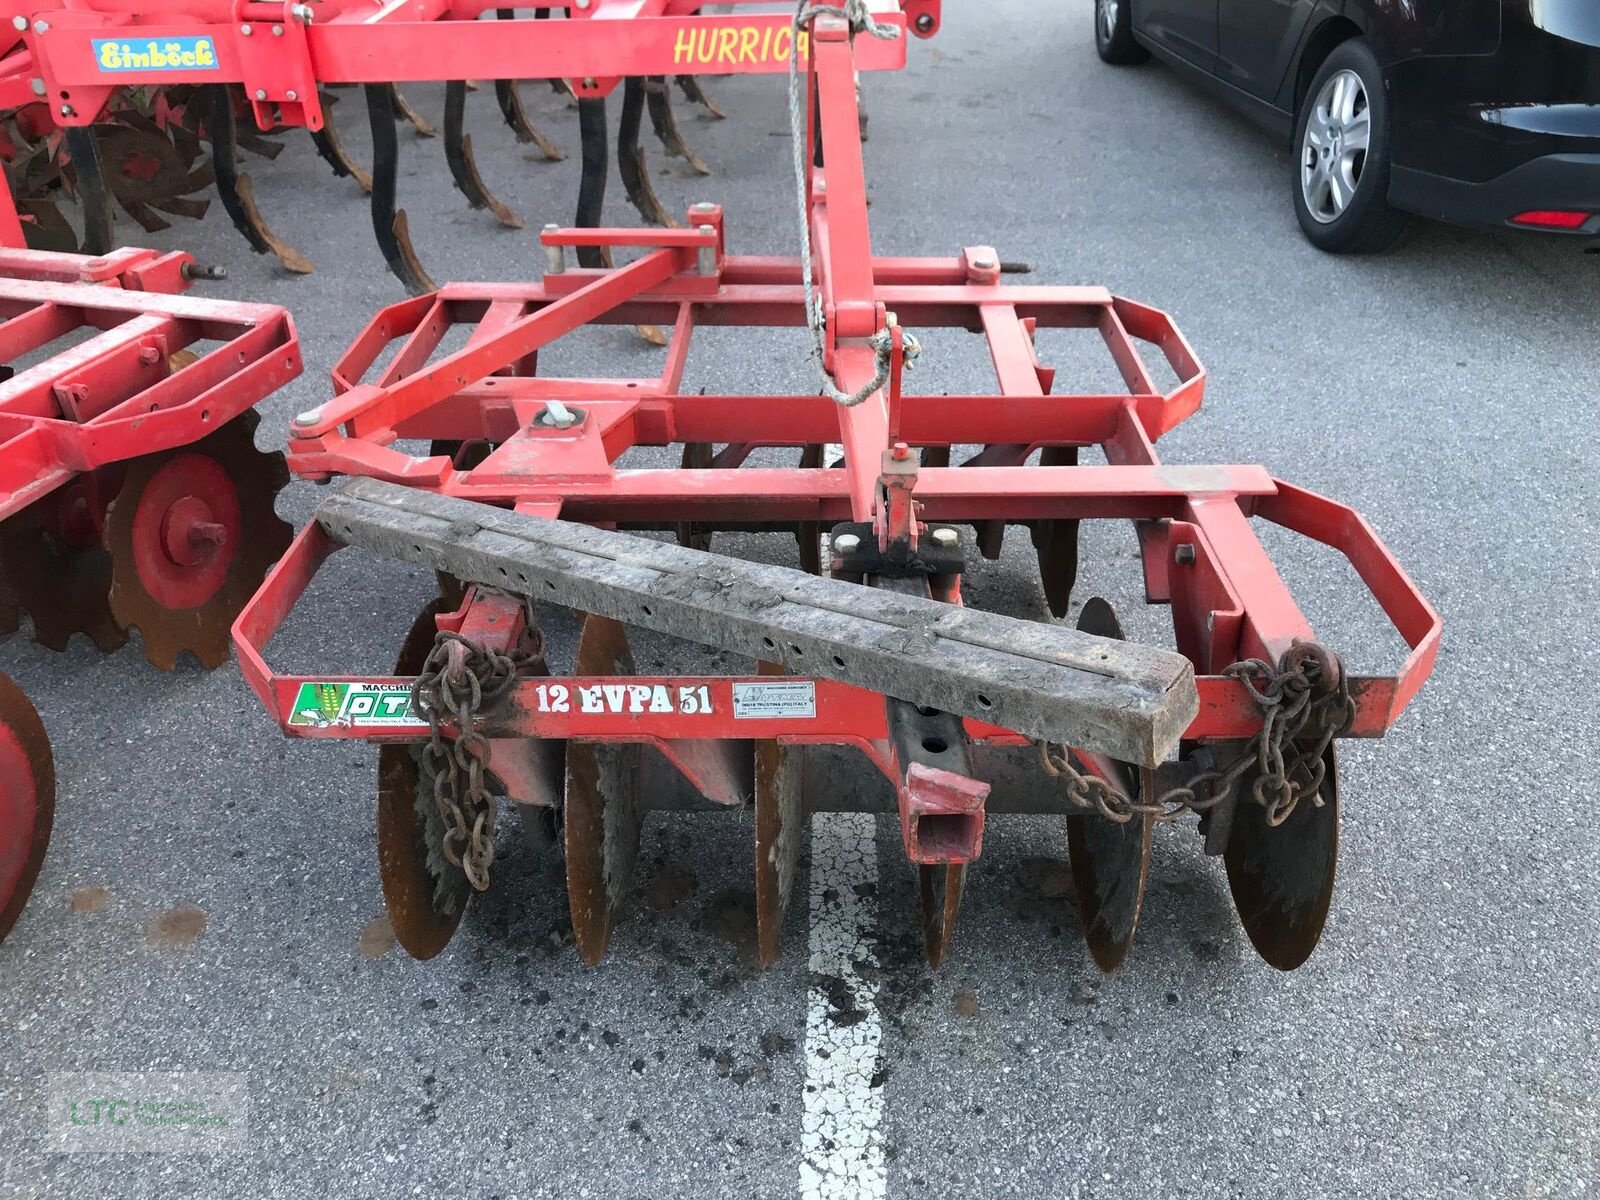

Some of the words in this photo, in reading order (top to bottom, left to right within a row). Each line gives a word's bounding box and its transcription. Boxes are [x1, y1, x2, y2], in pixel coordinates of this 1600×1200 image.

[100, 39, 215, 69] Einböck
[536, 684, 570, 713] 12
[579, 684, 674, 713] EVPA
[679, 685, 713, 714] 51
